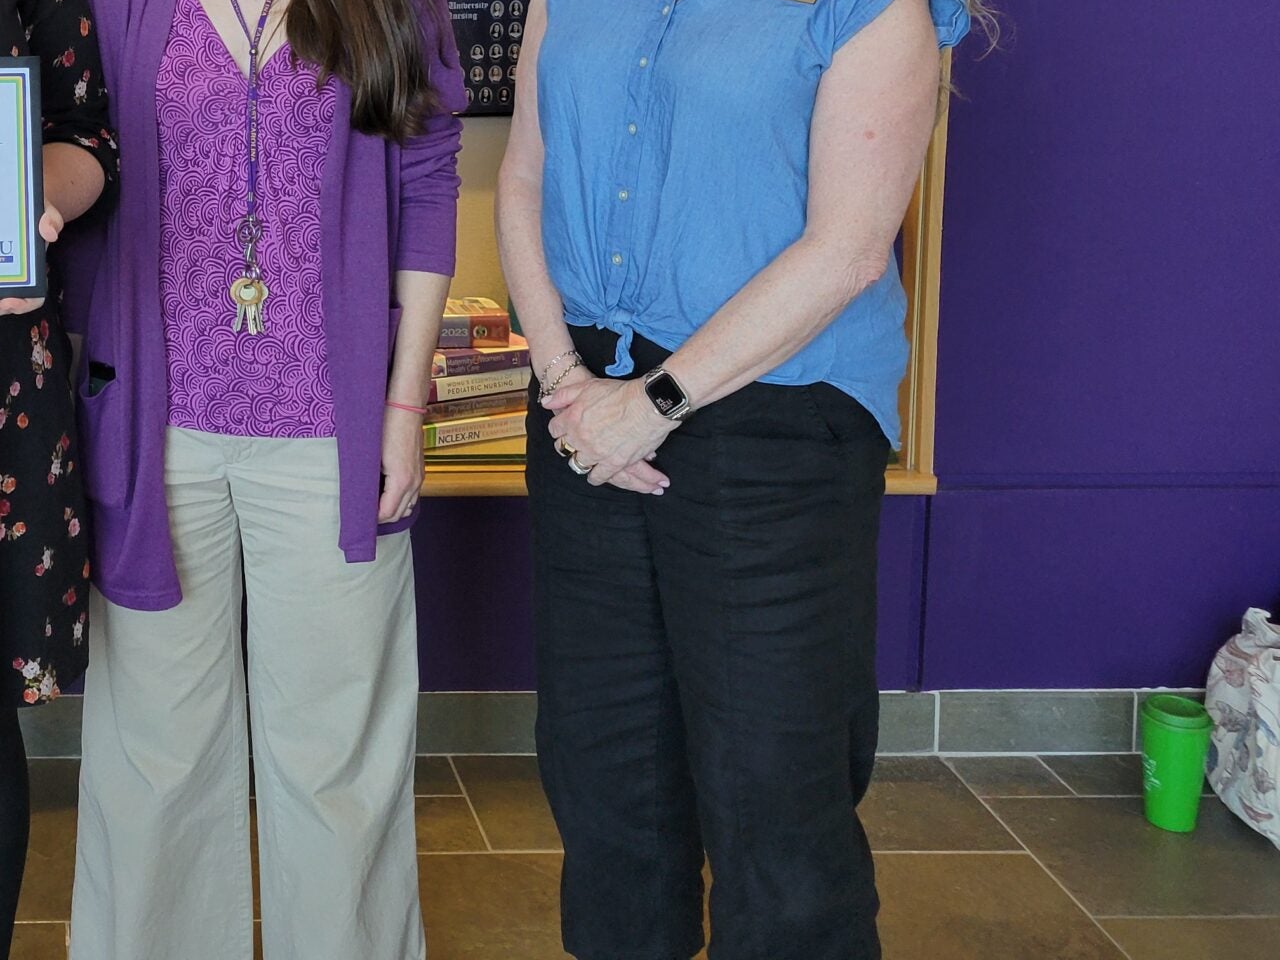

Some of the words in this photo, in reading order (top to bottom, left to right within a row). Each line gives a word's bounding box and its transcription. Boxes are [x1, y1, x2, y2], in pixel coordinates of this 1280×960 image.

[448, 1, 489, 10] University
[441, 328, 468, 337] 2023
[447, 384, 482, 395] PEDIATRIC
[484, 380, 514, 390] NURSING
[438, 431, 480, 444] NCLEX-RN
